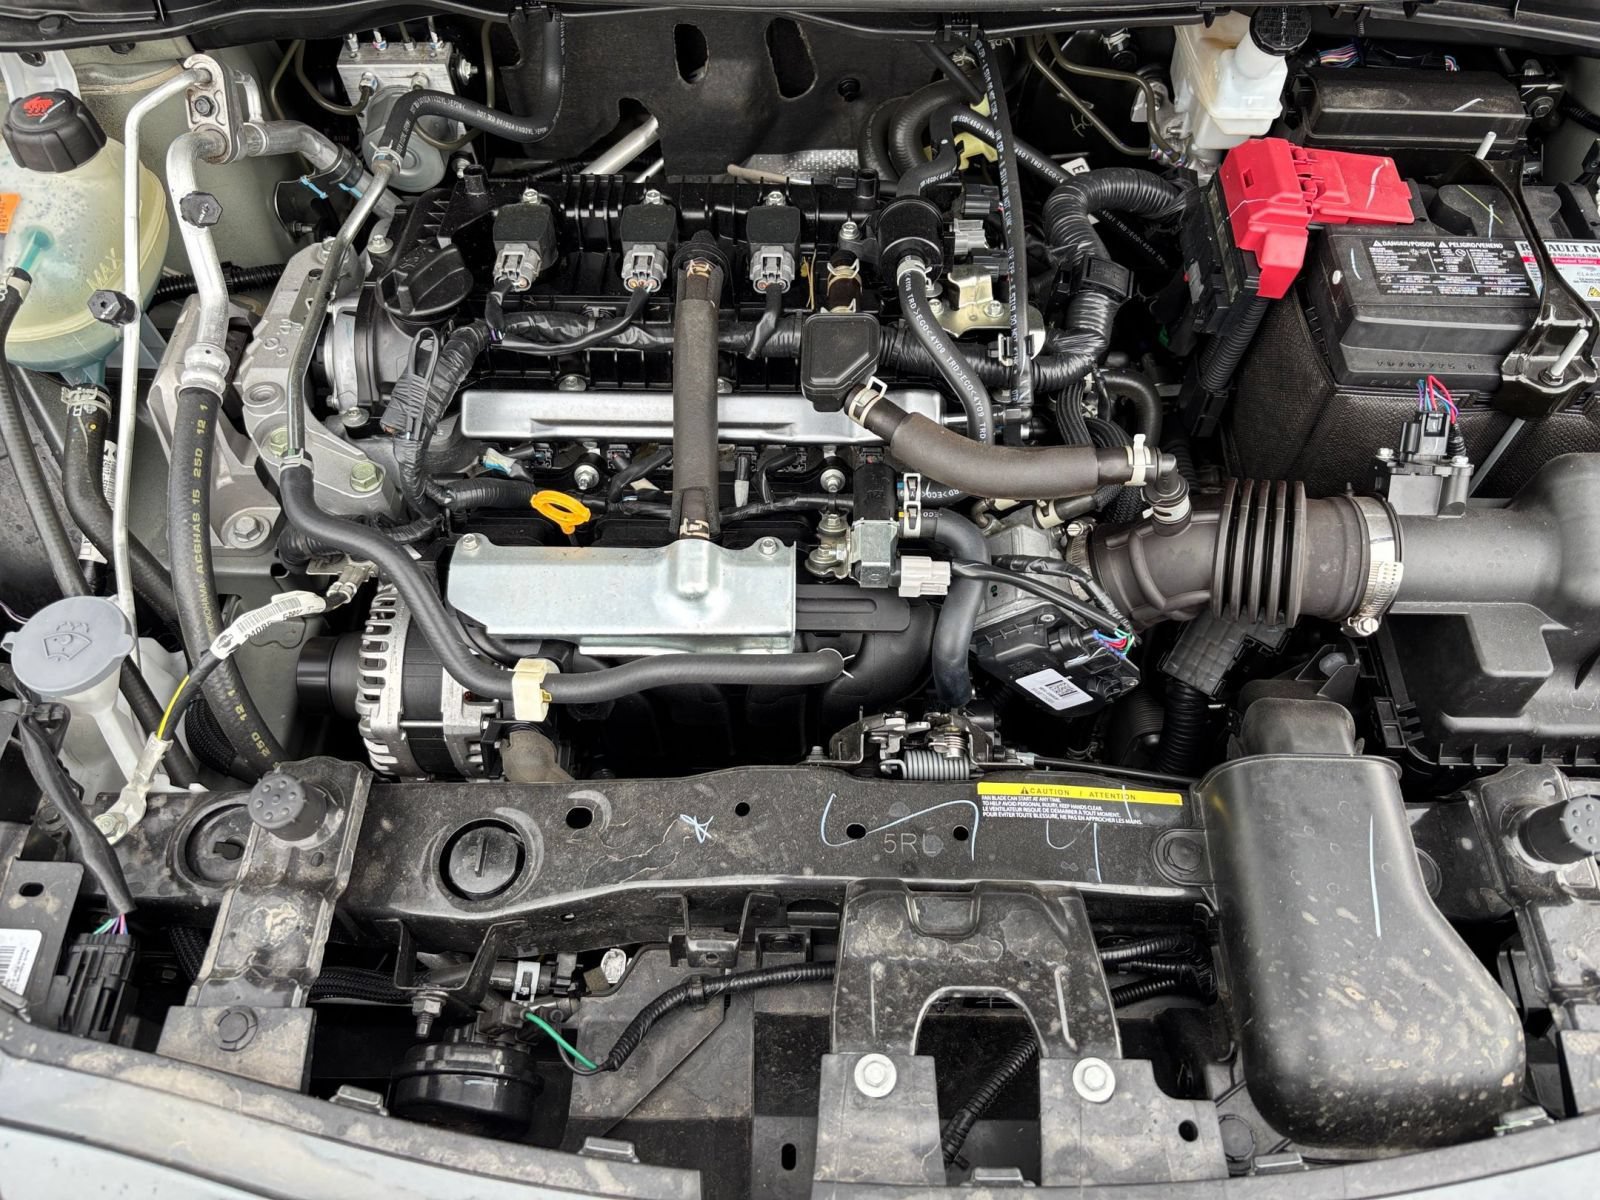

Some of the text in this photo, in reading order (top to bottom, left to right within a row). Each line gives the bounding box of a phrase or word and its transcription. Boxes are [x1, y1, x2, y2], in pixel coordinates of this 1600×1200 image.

[1030, 158, 1064, 184] TRD>ECO<4
[1520, 244, 1579, 252] RAULT
[86, 248, 121, 290] MAX
[197, 420, 205, 434] 12
[193, 448, 203, 477] 25D
[192, 488, 201, 506] 15
[252, 732, 269, 758] 25D
[1030, 788, 1070, 796] CAUTION
[1089, 792, 1136, 800] ATTENTION
